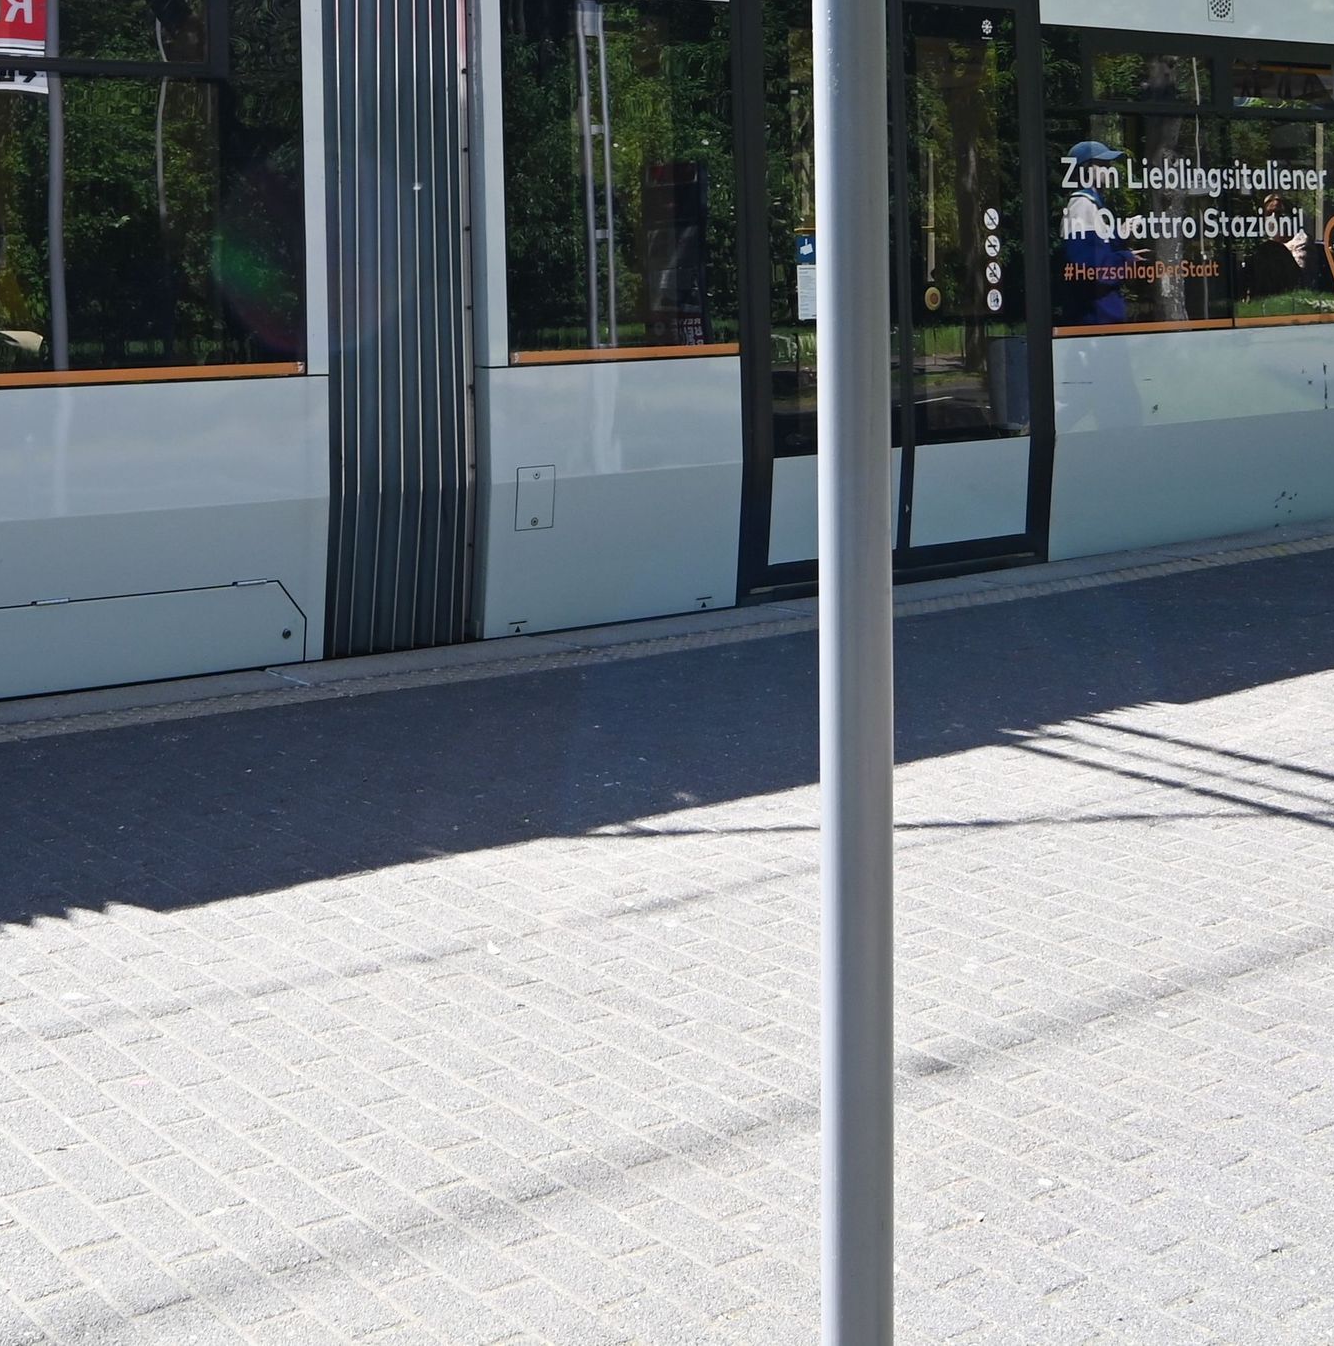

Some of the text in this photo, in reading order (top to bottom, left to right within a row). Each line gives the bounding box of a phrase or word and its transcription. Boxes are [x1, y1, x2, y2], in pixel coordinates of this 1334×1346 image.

[1060, 156, 1327, 198] Zum Lieblingsitaliener
[1063, 208, 1305, 244] in Quattro Stazioni!
[1063, 259, 1220, 284] #HerzschlagDerStadt
